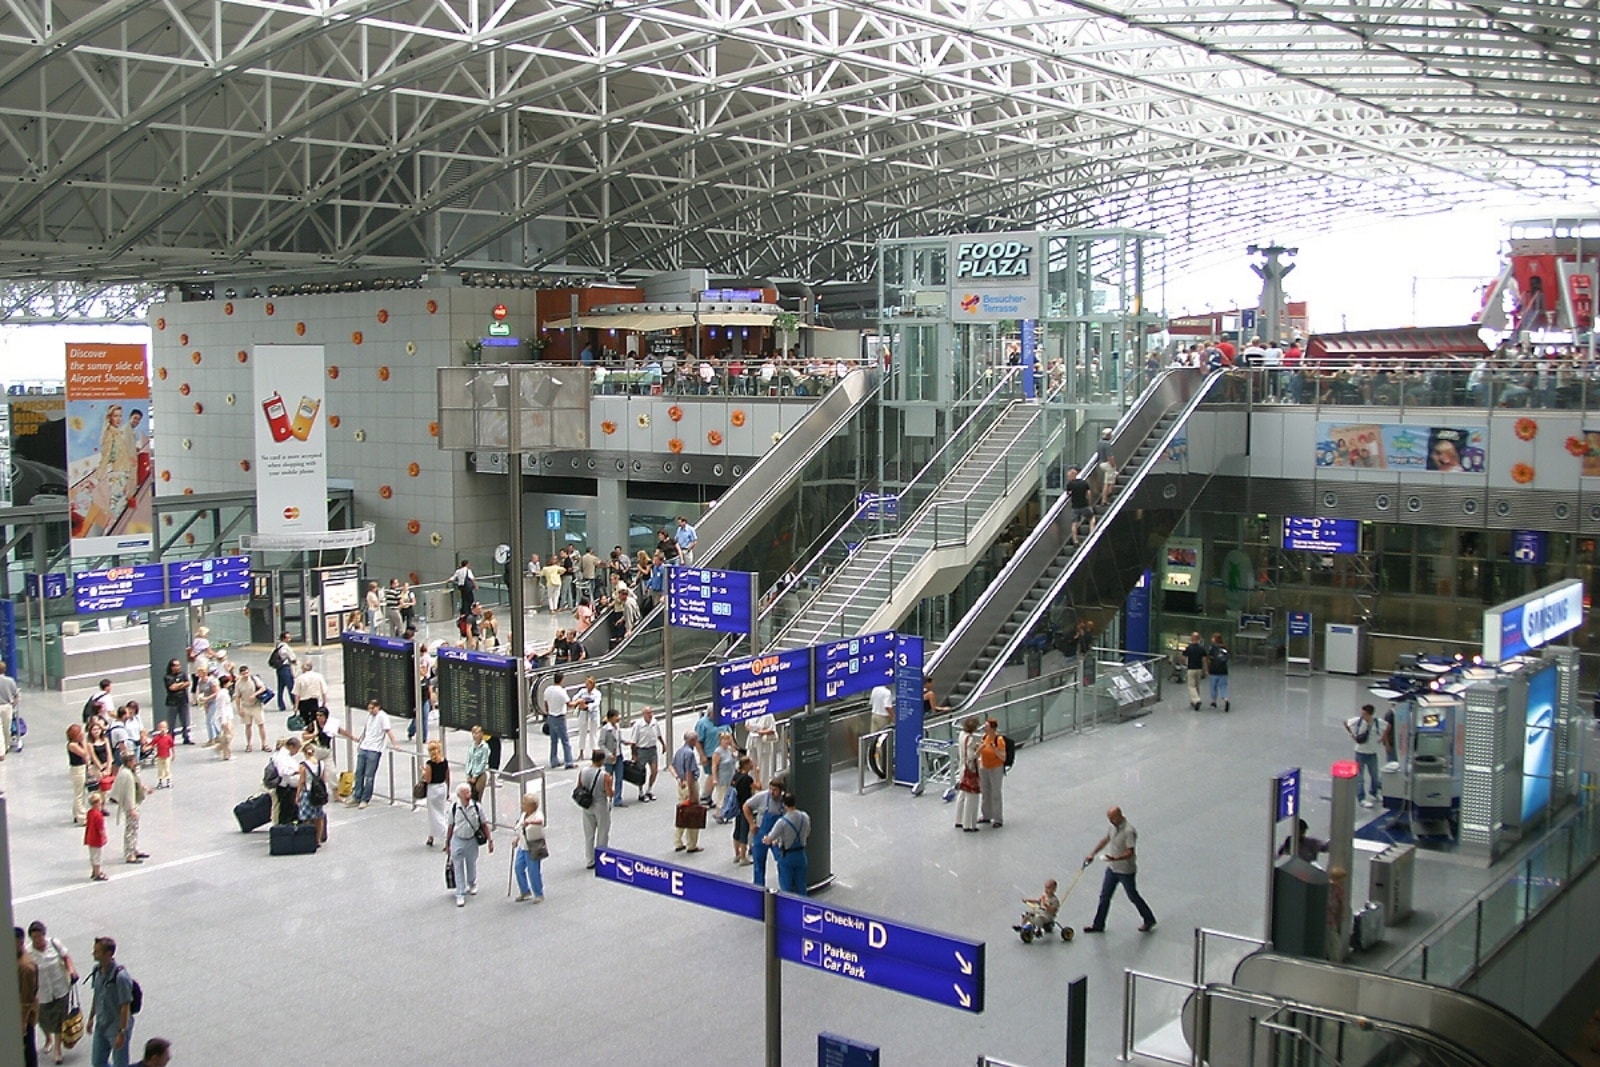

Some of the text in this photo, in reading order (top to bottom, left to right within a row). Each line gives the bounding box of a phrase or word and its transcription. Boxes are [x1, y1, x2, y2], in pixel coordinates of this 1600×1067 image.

[957, 242, 1031, 260] FOOD-
[957, 259, 1029, 277] PLAZA
[983, 295, 1026, 303] Besucher-
[983, 304, 1018, 312] Terrasse
[70, 349, 107, 358] Discover
[70, 361, 144, 373] the sunny side of
[70, 373, 145, 385] Airport Shopping
[1528, 598, 1568, 638] SAMSUNG
[898, 652, 908, 667] 3
[634, 861, 684, 896] Check-in E
[824, 911, 888, 949] Check-in D
[804, 940, 814, 956] P
[824, 943, 858, 963] Parken
[824, 957, 866, 979] Car Park
